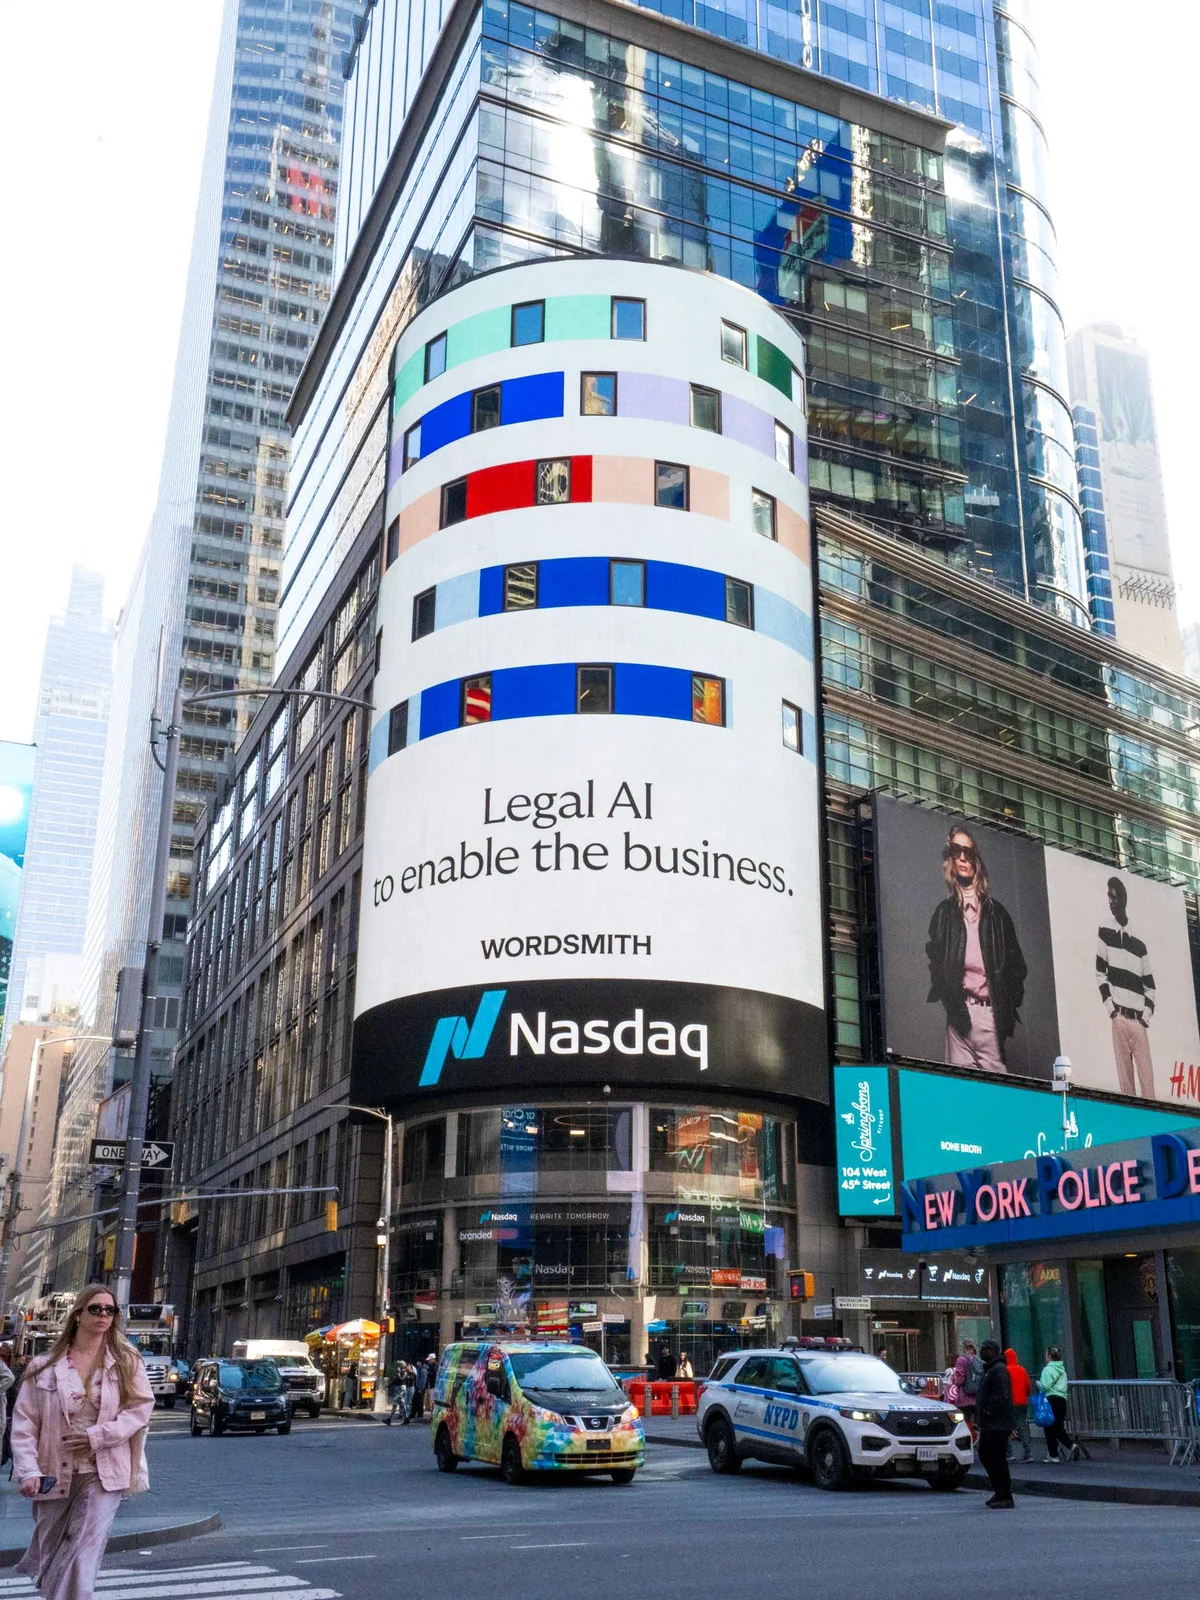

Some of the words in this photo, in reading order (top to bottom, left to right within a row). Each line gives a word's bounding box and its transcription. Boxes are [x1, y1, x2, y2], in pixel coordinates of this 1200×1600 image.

[483, 779, 595, 829] Legal
[607, 781, 653, 820] AI
[373, 873, 395, 907] to
[401, 836, 520, 894] enable
[531, 831, 609, 871] the
[623, 831, 794, 897] business.
[480, 934, 652, 960] WORDSMITH
[509, 1008, 709, 1071] Nasdaq
[1170, 1060, 1200, 1103] H&M
[851, 1081, 876, 1162] Springbone
[102, 1147, 125, 1158] ONE
[940, 1141, 960, 1152] BONE
[961, 1142, 982, 1154] BROTH
[842, 1167, 860, 1177] 104
[862, 1167, 887, 1177] West
[841, 1179, 860, 1190] 45th
[862, 1180, 890, 1190] Street
[900, 1180, 956, 1233] NEW
[956, 1168, 1031, 1225] YORK
[1036, 1155, 1141, 1215] POLICE
[491, 1213, 517, 1222] Nasdaq
[530, 1212, 562, 1220] REWRITE
[566, 1212, 610, 1220] TOMORROW
[678, 1213, 705, 1223] Nasdaq
[535, 1263, 574, 1275] Nasdaq
[952, 1272, 970, 1282] Nasdaq
[763, 1404, 799, 1430] NYPD
